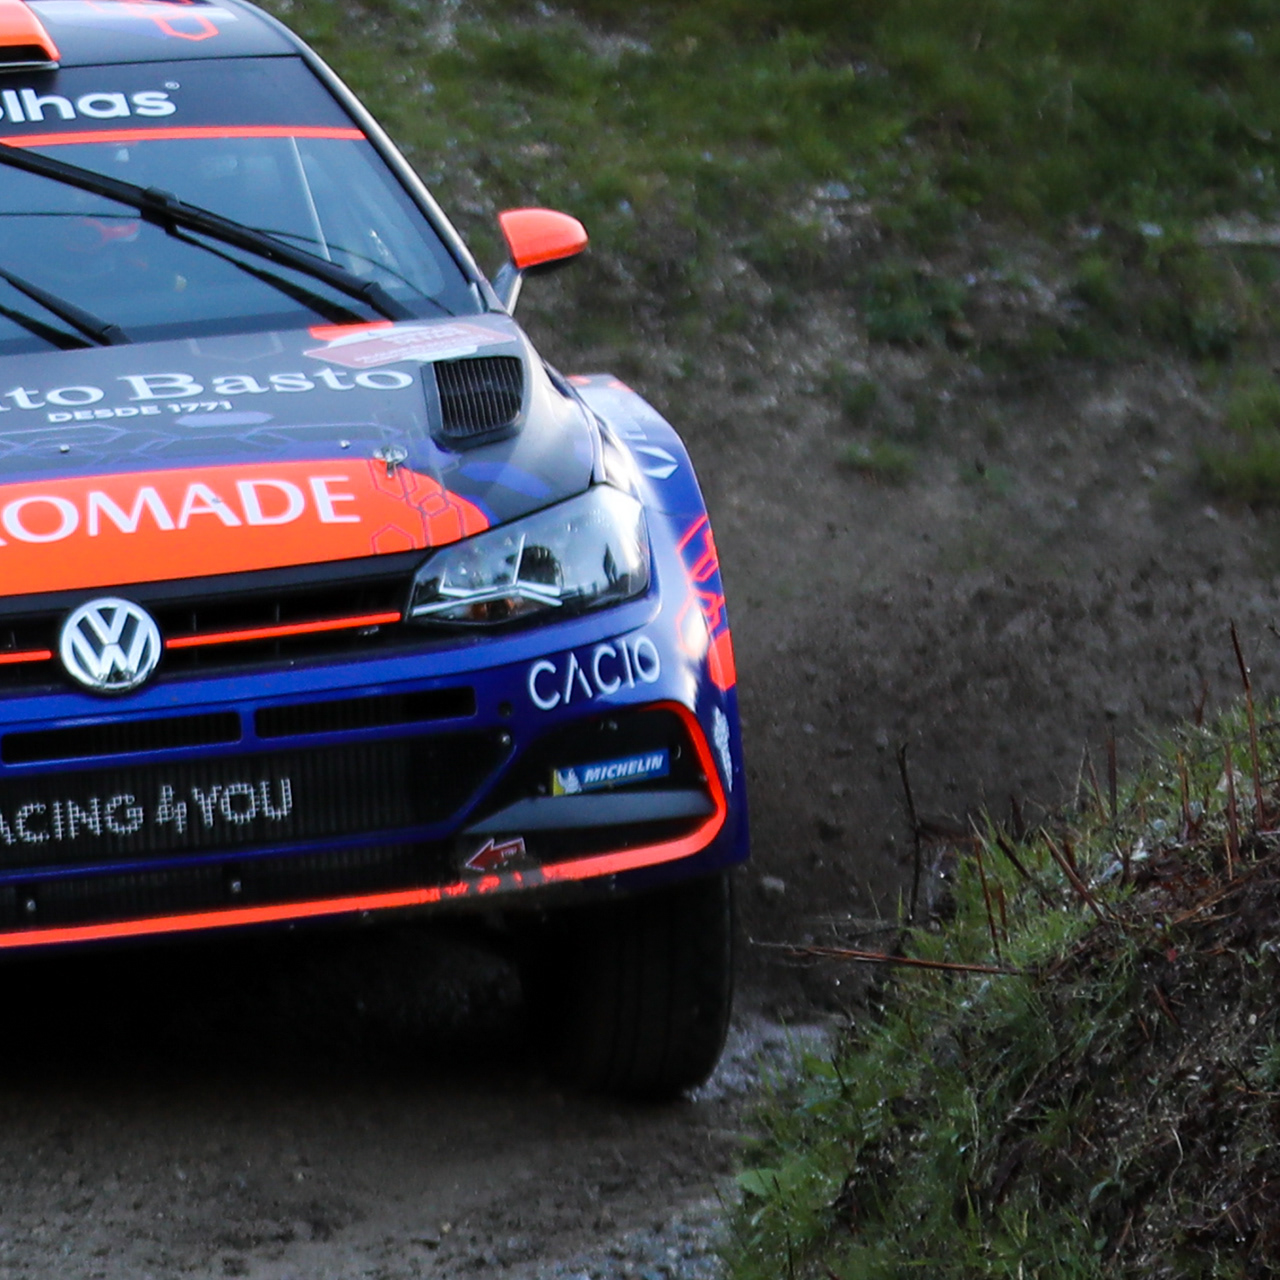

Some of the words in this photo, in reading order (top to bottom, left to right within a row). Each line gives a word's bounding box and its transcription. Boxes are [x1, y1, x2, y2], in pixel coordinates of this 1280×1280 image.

[116, 367, 414, 402] Basto
[47, 405, 162, 423] DESDE
[167, 401, 233, 414] 1771
[528, 635, 661, 710] CACIO
[584, 754, 664, 783] MICHELIN
